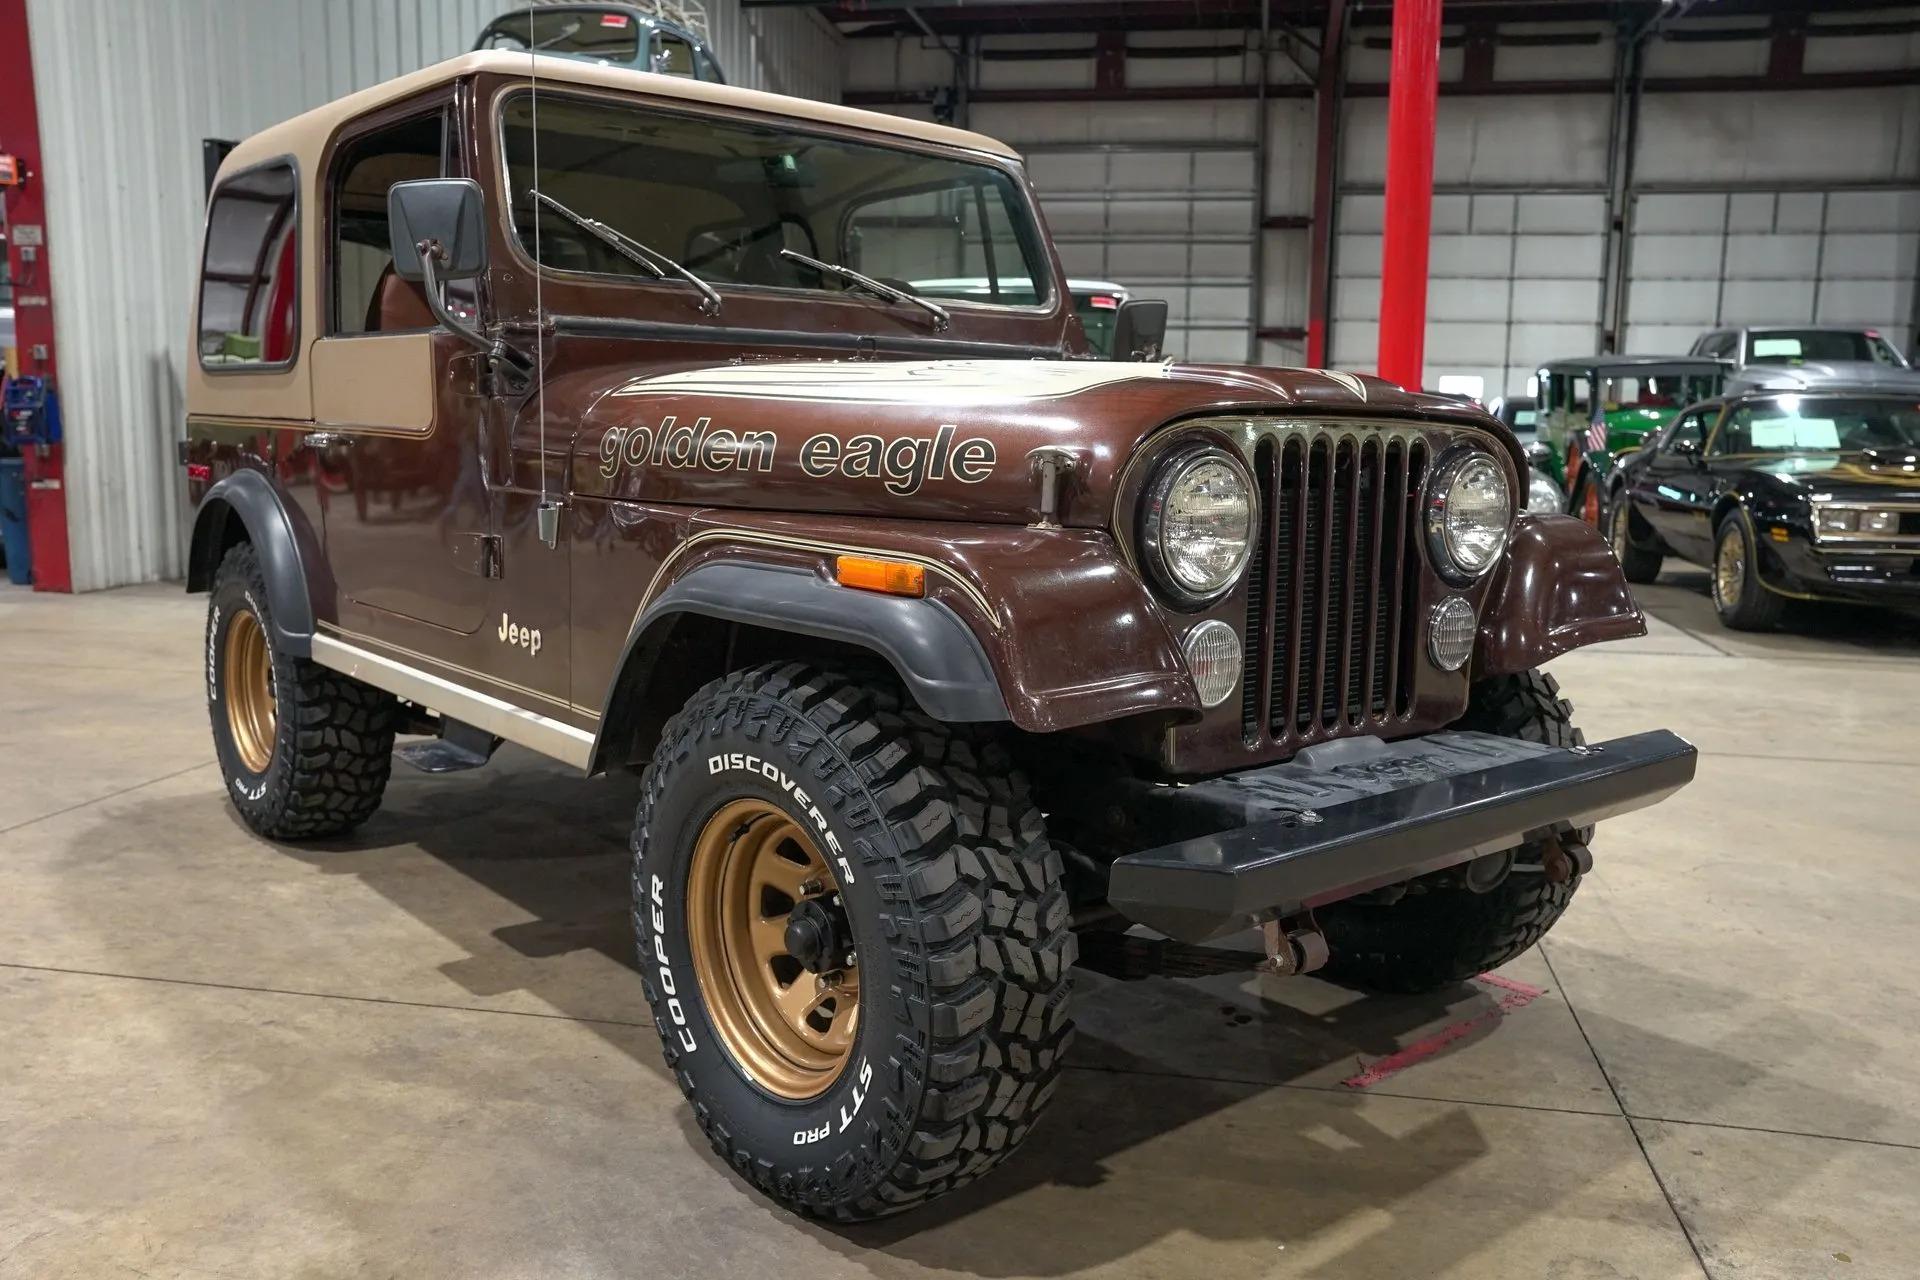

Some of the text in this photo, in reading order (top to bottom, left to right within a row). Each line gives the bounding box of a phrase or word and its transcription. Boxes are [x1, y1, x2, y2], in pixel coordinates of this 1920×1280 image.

[599, 415, 997, 497] golden eagle
[208, 605, 221, 700] COOPER
[498, 612, 542, 656] Jeep
[708, 753, 855, 885] DISCOVERER
[651, 873, 698, 1053] COOPER
[793, 1055, 873, 1145] STT PRO
